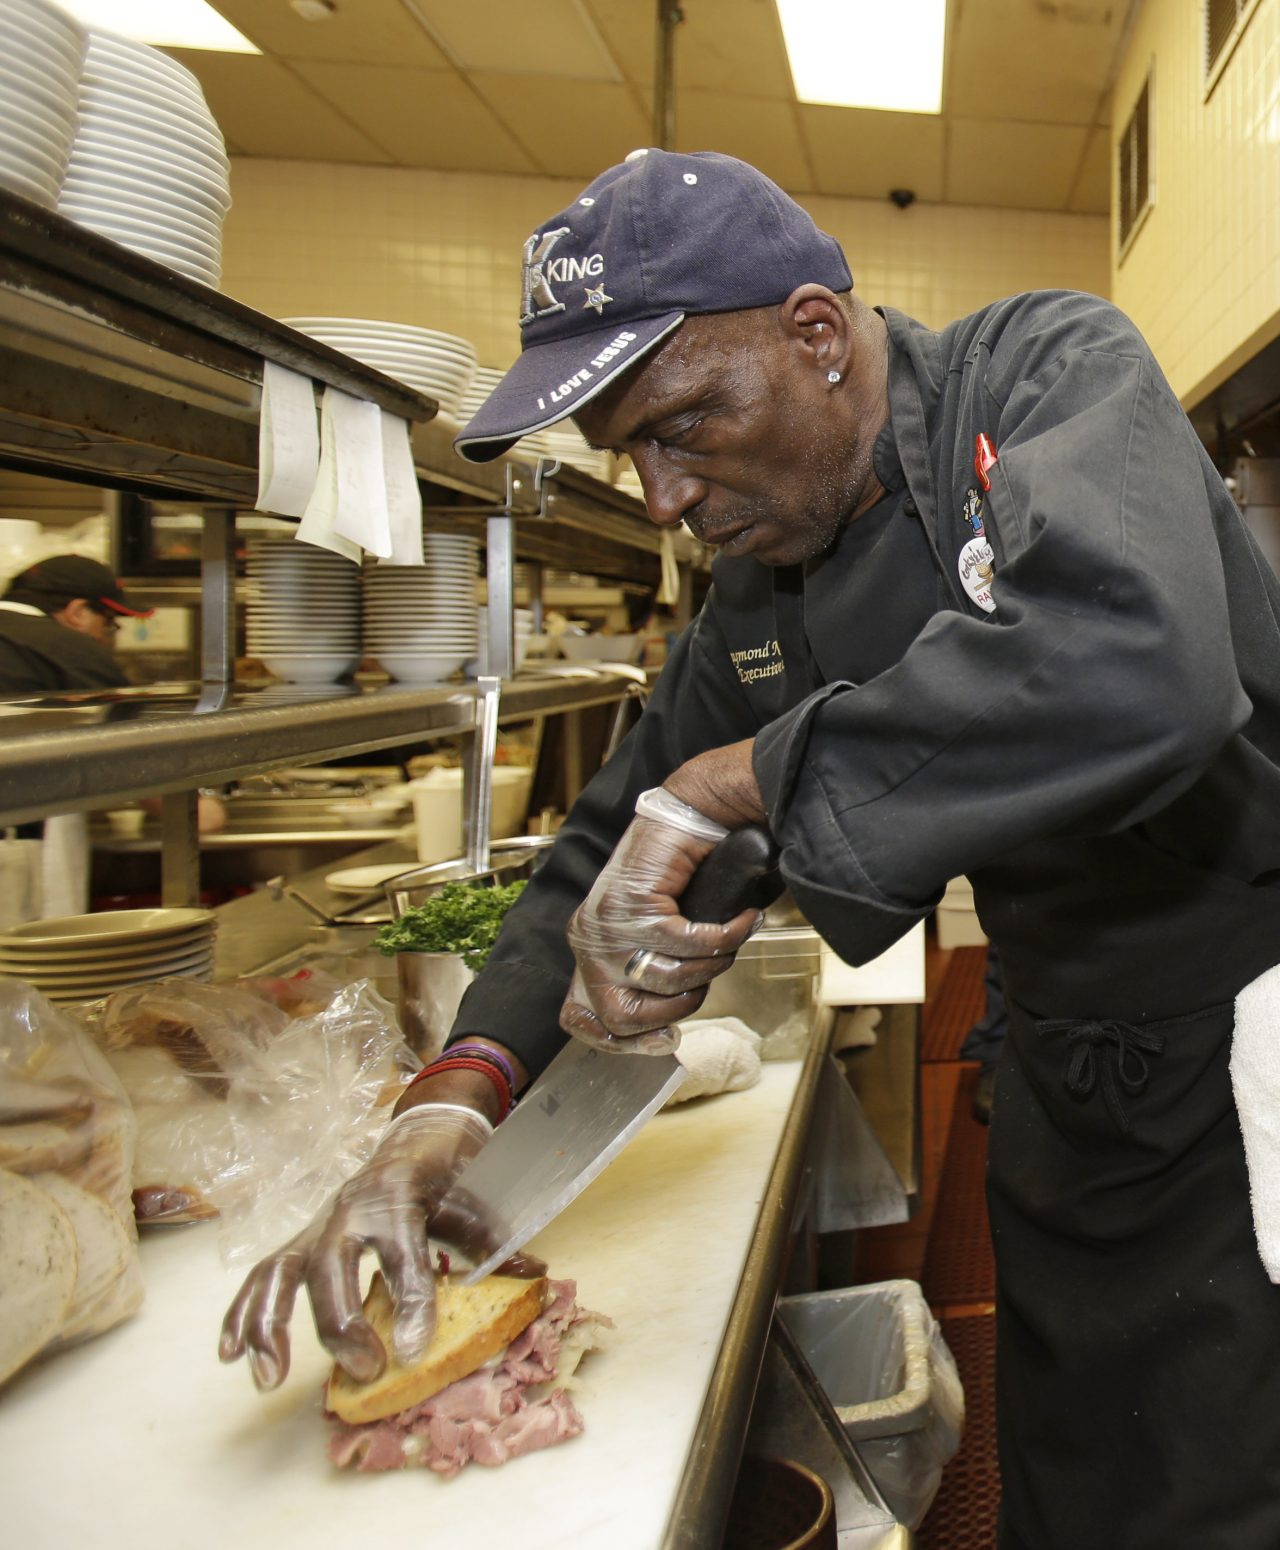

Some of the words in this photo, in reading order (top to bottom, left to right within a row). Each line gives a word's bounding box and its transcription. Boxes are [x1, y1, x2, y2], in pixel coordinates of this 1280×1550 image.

[546, 253, 604, 285] KING
[537, 398, 546, 410] I
[550, 369, 593, 403] LOVE
[590, 331, 637, 369] JESUS
